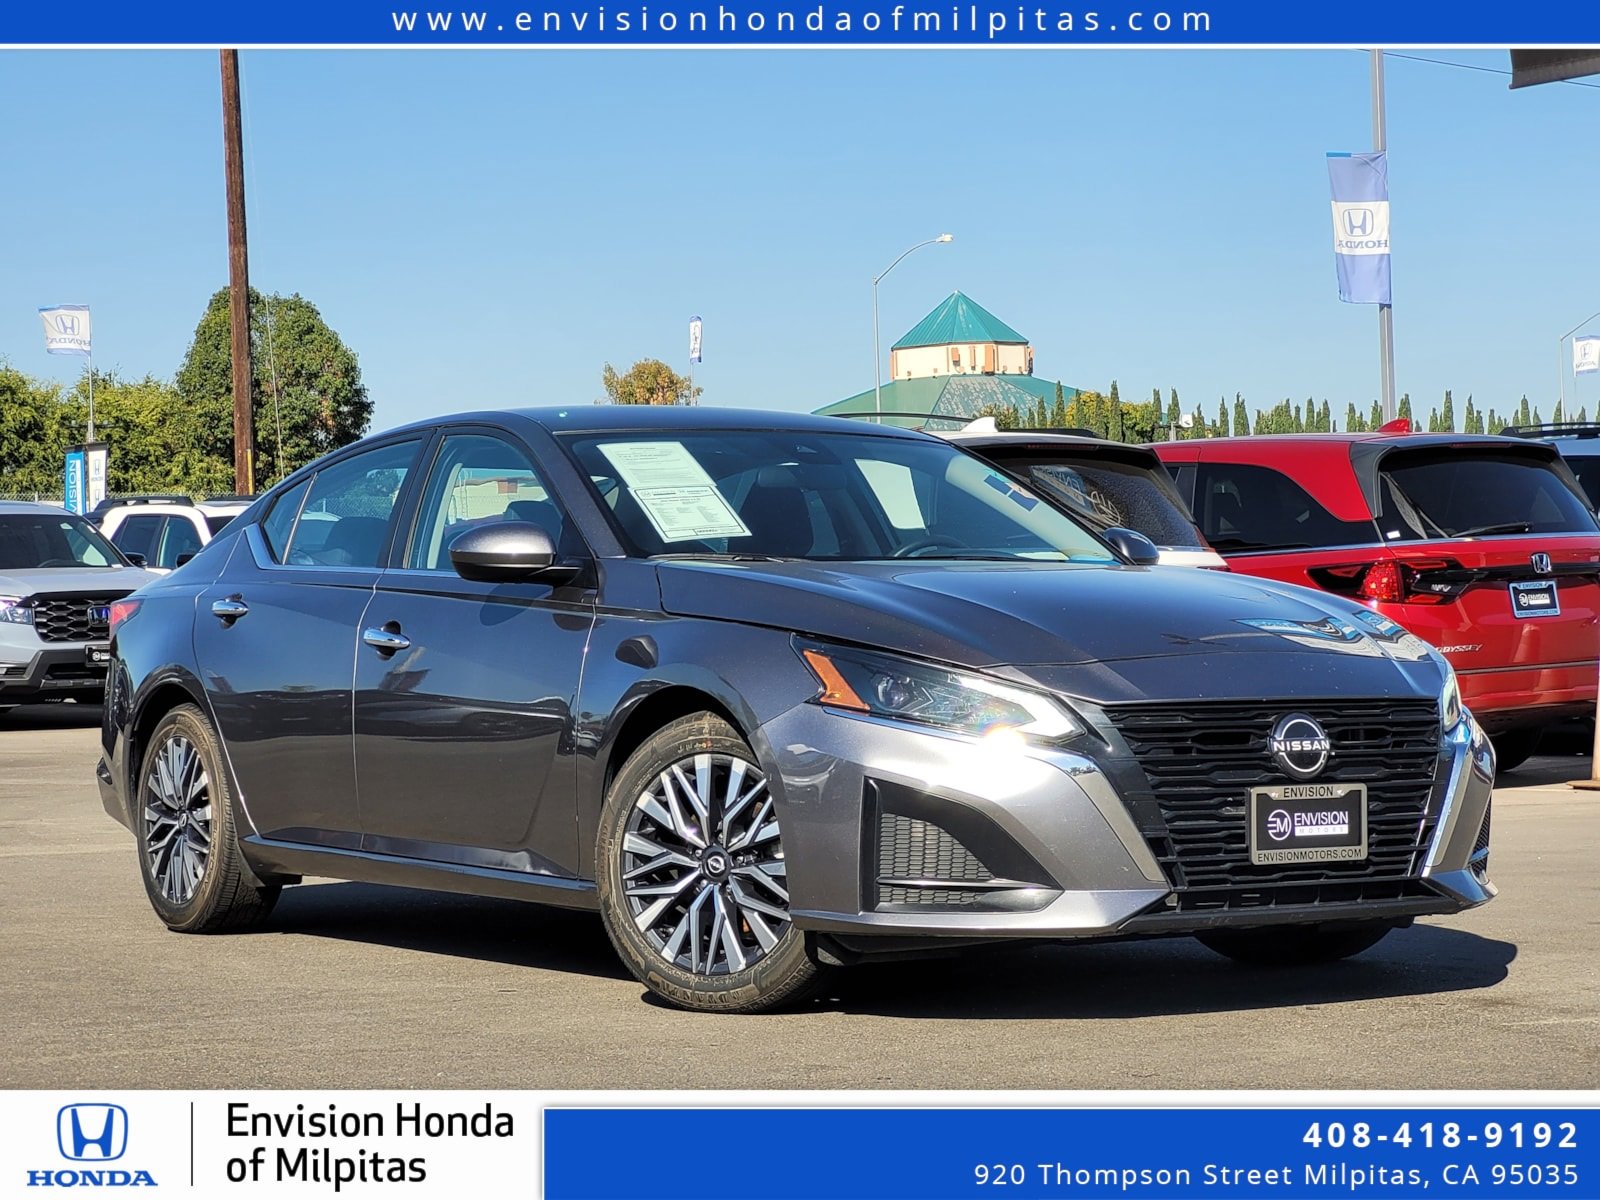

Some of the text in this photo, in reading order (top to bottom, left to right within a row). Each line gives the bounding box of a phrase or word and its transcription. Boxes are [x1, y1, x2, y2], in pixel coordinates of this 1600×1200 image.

[1273, 739, 1330, 752] NISSAN
[1283, 786, 1334, 798] ENVISION
[1294, 811, 1349, 827] ENVISION
[1257, 848, 1362, 863] ENVISIONMOTORS.COM
